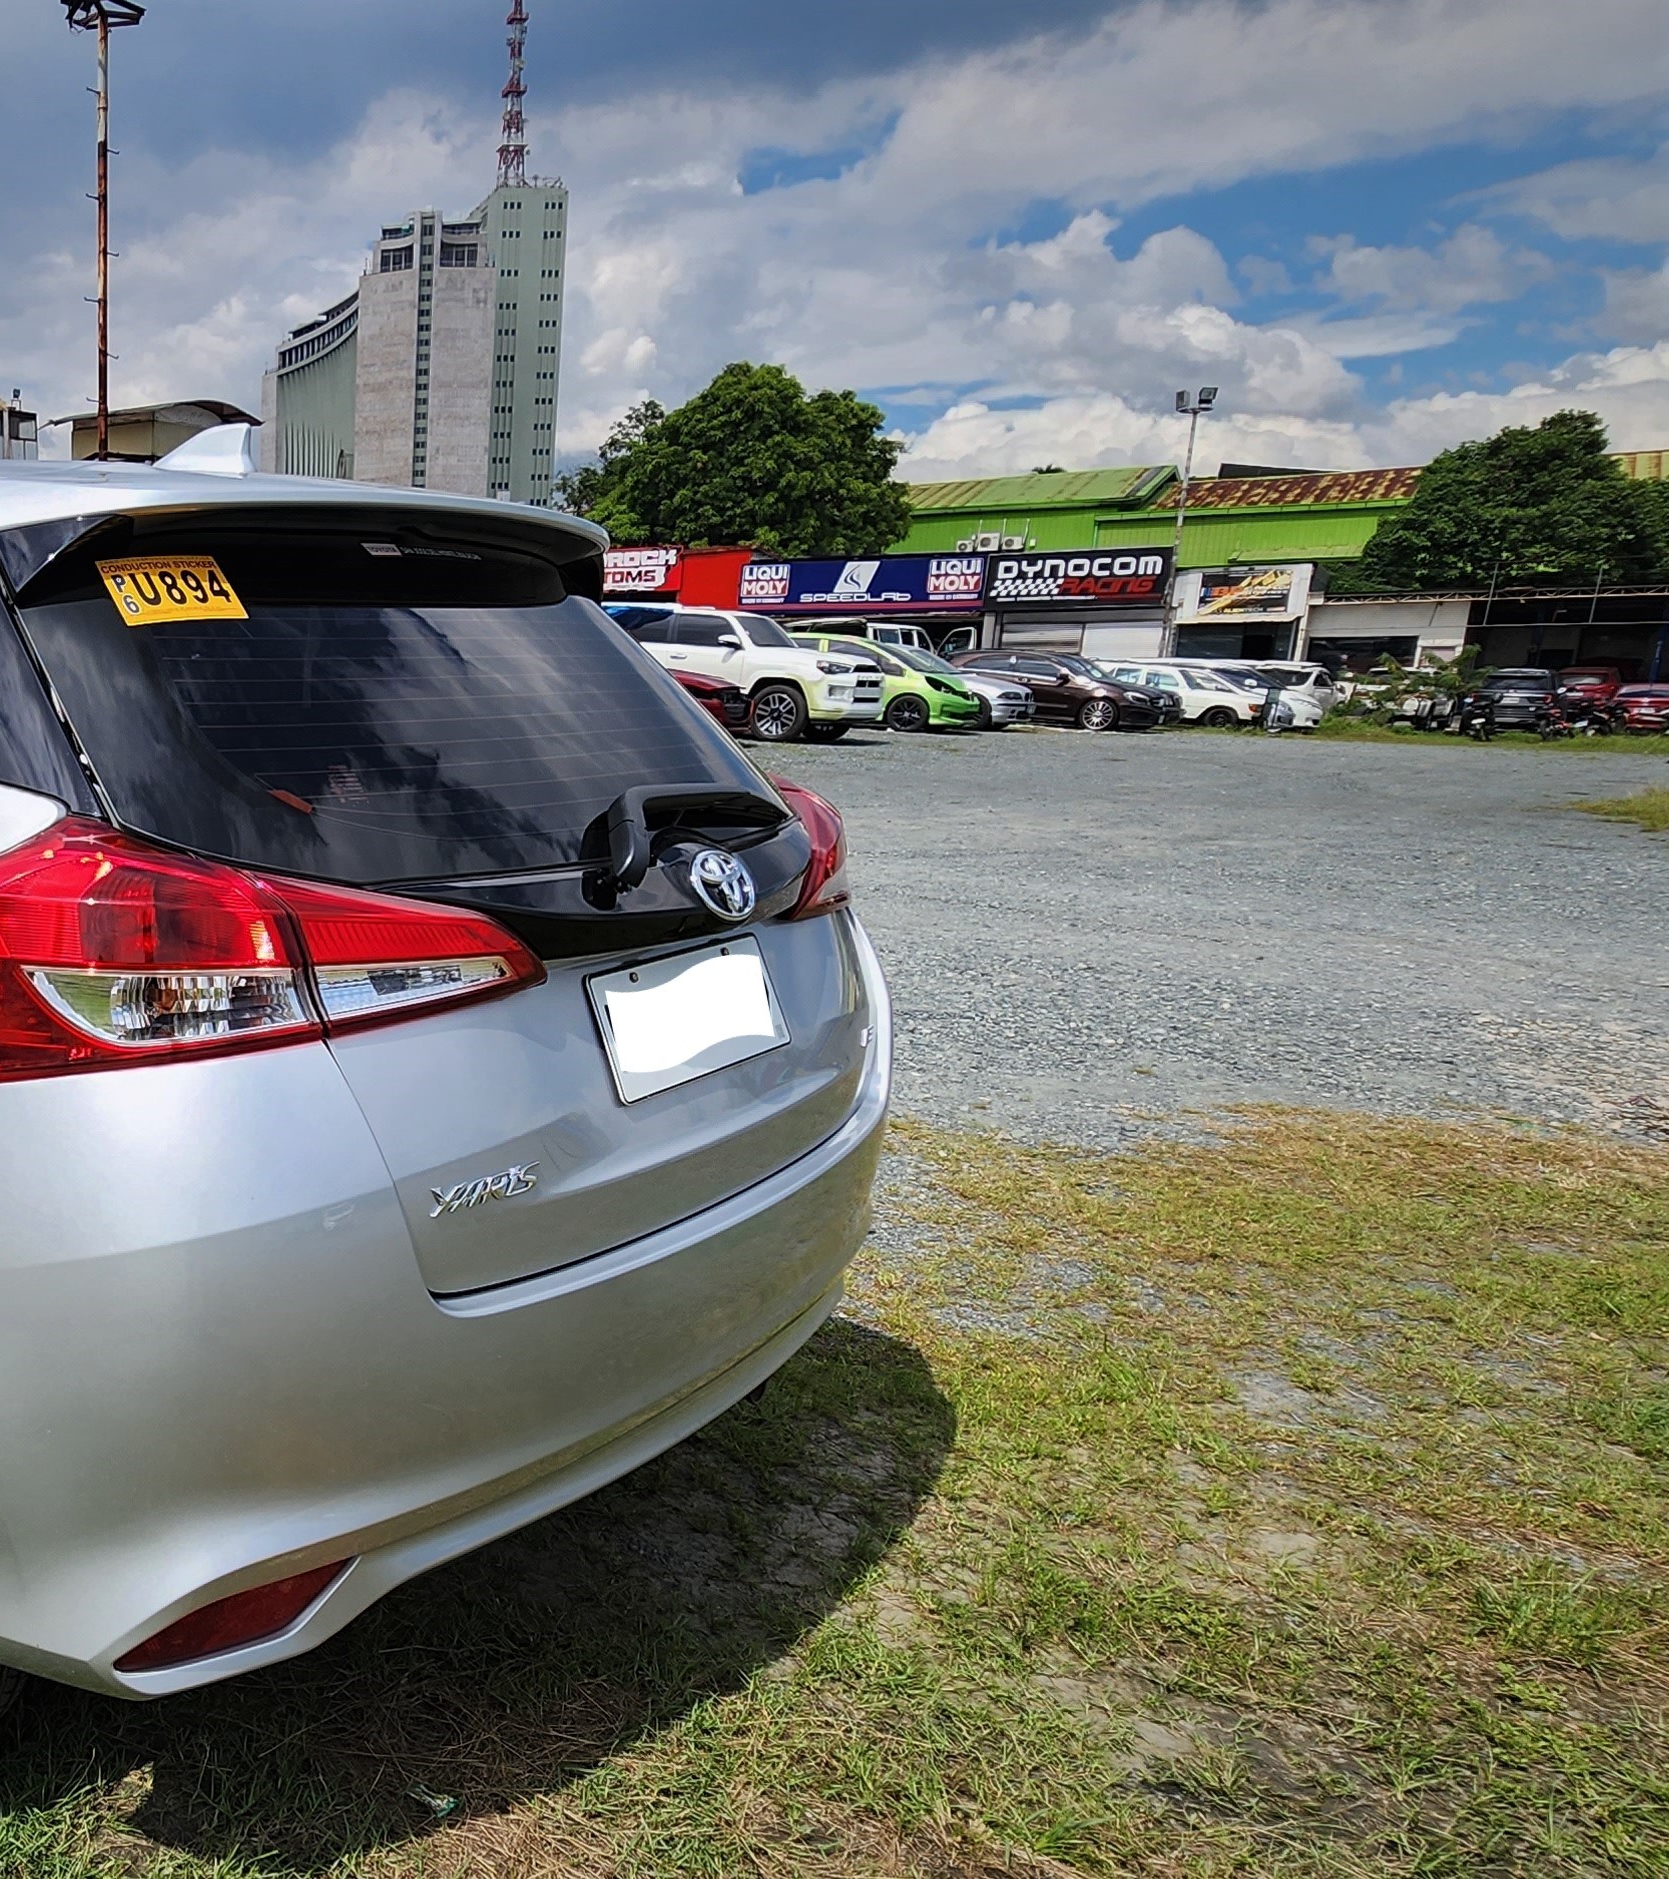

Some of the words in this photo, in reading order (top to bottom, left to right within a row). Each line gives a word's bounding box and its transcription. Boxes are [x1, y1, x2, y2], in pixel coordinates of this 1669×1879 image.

[603, 549, 678, 567] ROCK
[100, 561, 172, 575] CONDUCTION
[173, 560, 218, 569] STICKER
[744, 566, 788, 580] LIQUI
[931, 559, 982, 575] LIQUI
[997, 555, 1163, 579] DYNOCOM
[742, 580, 786, 595] MOLY
[929, 575, 980, 591] MOLY
[1060, 576, 1157, 594] RACING
